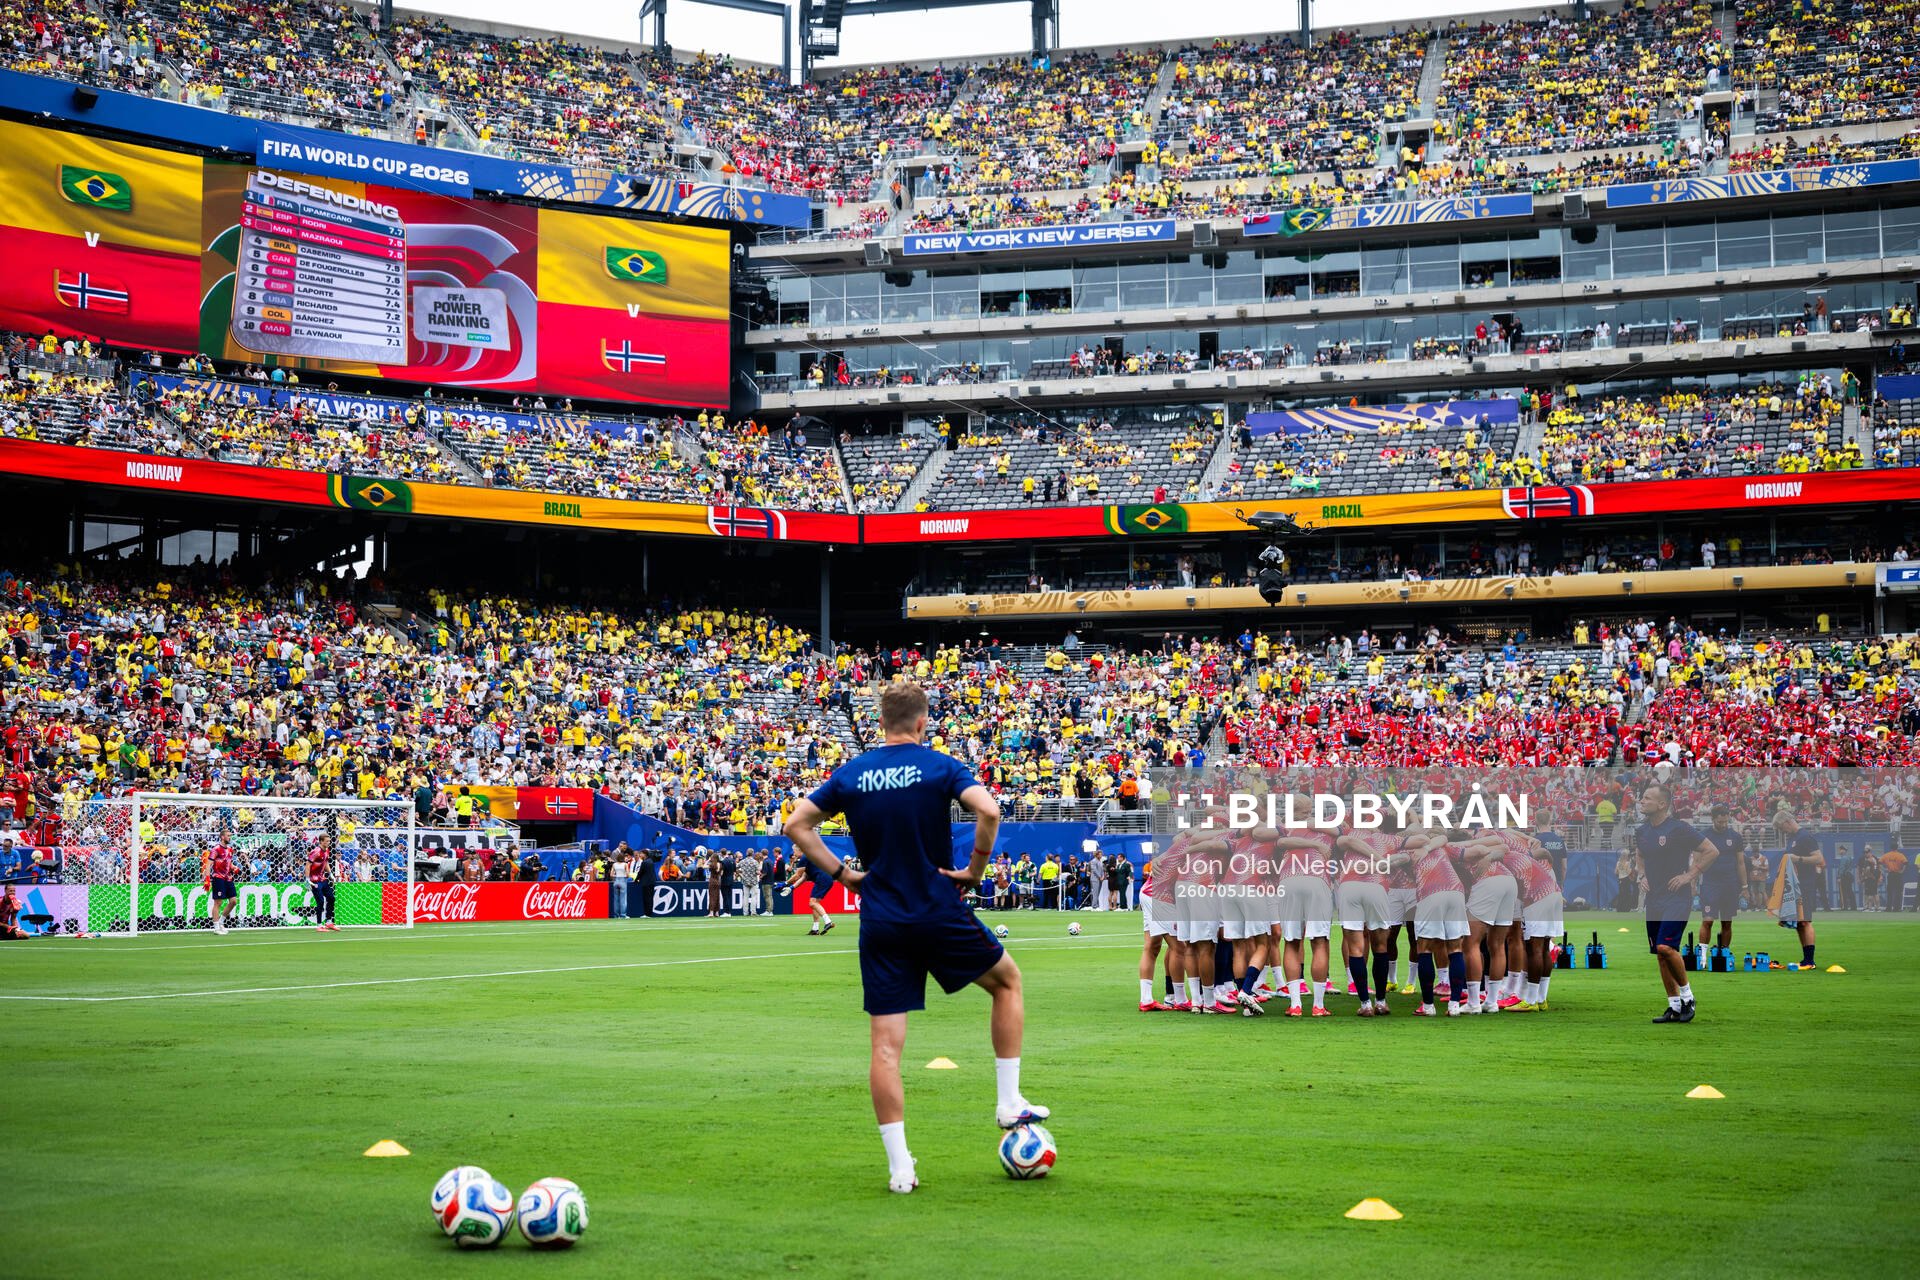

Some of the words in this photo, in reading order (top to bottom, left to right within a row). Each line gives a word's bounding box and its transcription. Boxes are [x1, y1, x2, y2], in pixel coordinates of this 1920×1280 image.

[263, 139, 303, 160] FIFA
[304, 145, 370, 169] WORLD
[372, 157, 408, 175] CUP
[409, 163, 470, 185] 2026
[257, 170, 400, 219] DEFENDING
[245, 204, 253, 212] 2
[275, 212, 292, 220] ESP
[302, 219, 327, 229] RODRI
[388, 238, 403, 247] 7.5
[247, 191, 254, 200] 1
[276, 200, 293, 209] FRA
[303, 206, 353, 223] UPAMECANO
[388, 227, 403, 236] 7.7
[244, 217, 252, 226] 3
[273, 225, 293, 235] MAR
[301, 231, 343, 246] MAZRAOUI
[388, 250, 403, 260] 7.5
[915, 236, 962, 250] NEW
[967, 232, 1023, 248] YORK
[1028, 228, 1076, 245] NEW
[1079, 224, 1163, 241] JERSEY
[253, 250, 260, 258] 5
[271, 254, 291, 263] CAN
[312, 263, 365, 277] FOUGEROLLES
[385, 276, 400, 284] 7.5
[254, 236, 262, 245] 4
[273, 241, 291, 250] BRA
[300, 247, 342, 260] CASEMIRO
[385, 264, 400, 272] 7.5
[250, 277, 258, 286] 7
[297, 286, 334, 297] LAPORTE
[385, 300, 400, 309] 7.4
[251, 264, 259, 272] 6
[385, 288, 400, 296] 7.4
[248, 292, 256, 300] 8
[296, 300, 338, 311] RICHARDS
[385, 313, 400, 321] 7.2
[433, 301, 482, 316] POWER
[447, 293, 465, 302] FIFA
[243, 321, 255, 329] 10
[264, 324, 286, 333] MAR
[386, 338, 400, 347] 7.1
[246, 306, 255, 315] 9
[267, 310, 285, 318] COL
[386, 325, 400, 334] 7.1
[428, 313, 490, 329] RANKING
[126, 461, 183, 482] NORWAY
[1745, 481, 1803, 500] NORWAY
[543, 501, 582, 518] BRAZIL
[1322, 504, 1364, 519] BRAZIL
[920, 518, 969, 535] NORWAY
[1902, 570, 1920, 579] F
[522, 883, 590, 919] Coca-Cola
